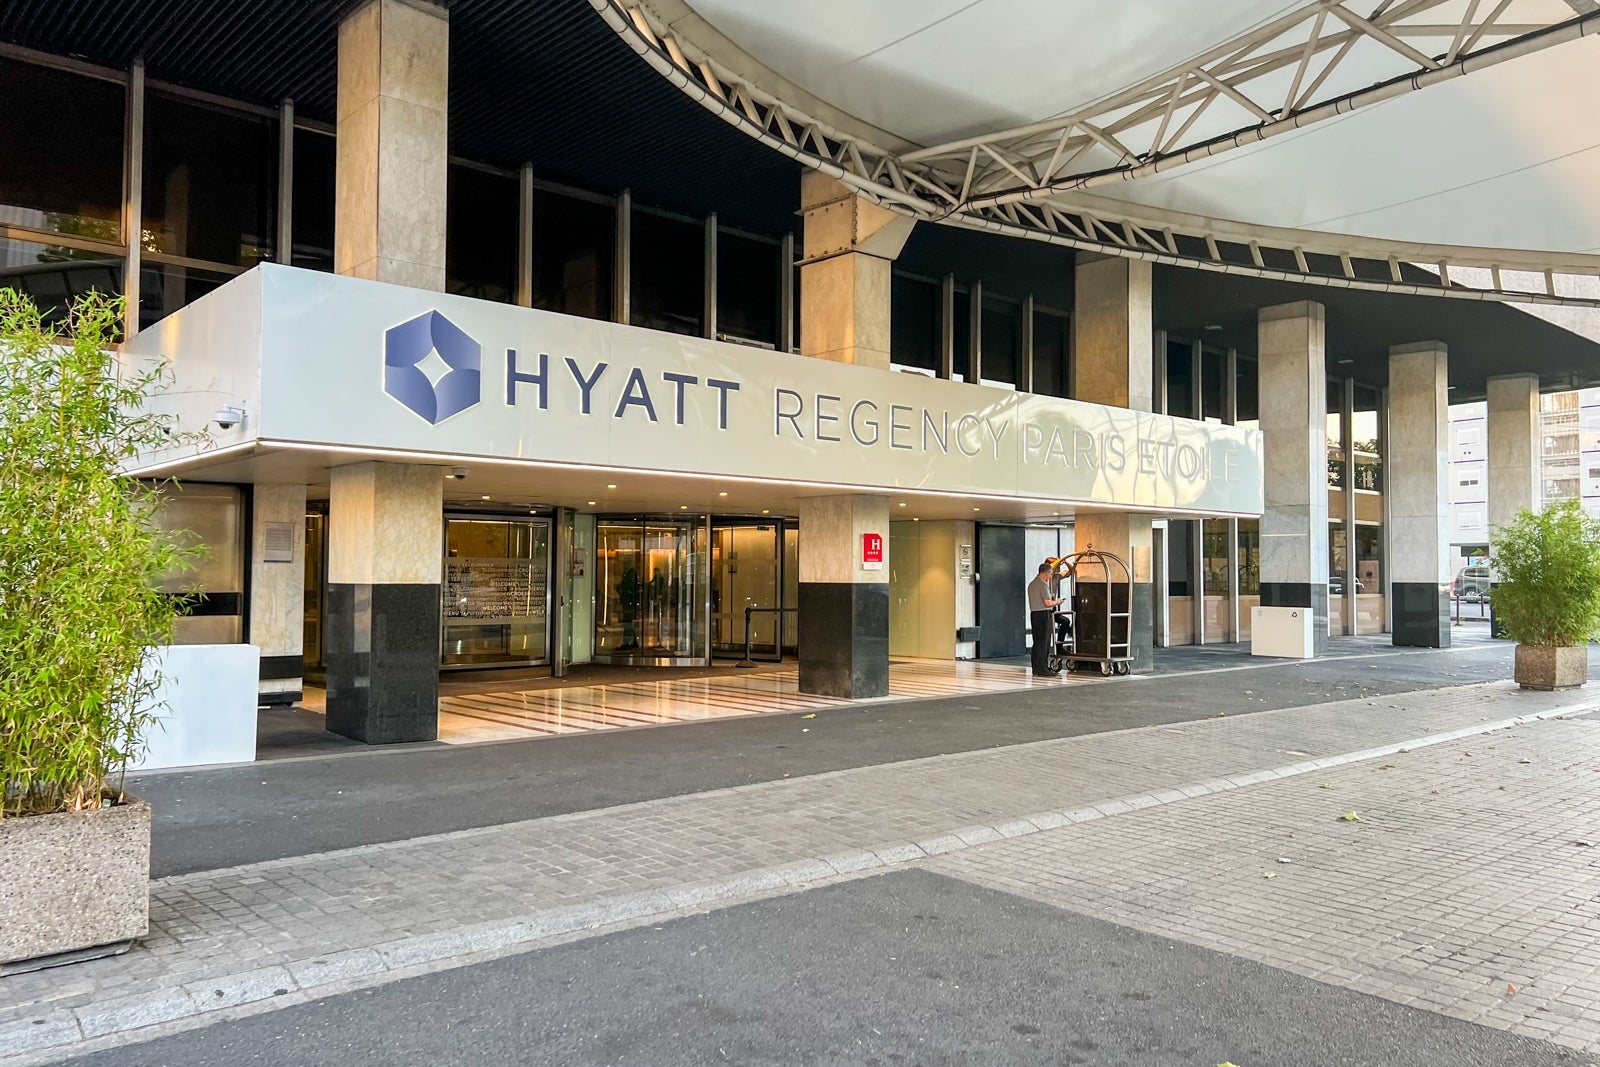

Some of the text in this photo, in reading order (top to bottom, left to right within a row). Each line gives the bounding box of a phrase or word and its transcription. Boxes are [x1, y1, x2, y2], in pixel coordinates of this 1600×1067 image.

[506, 349, 1240, 483] HYATT REGENCY PARIS ETOILE
[871, 539, 881, 550] H
